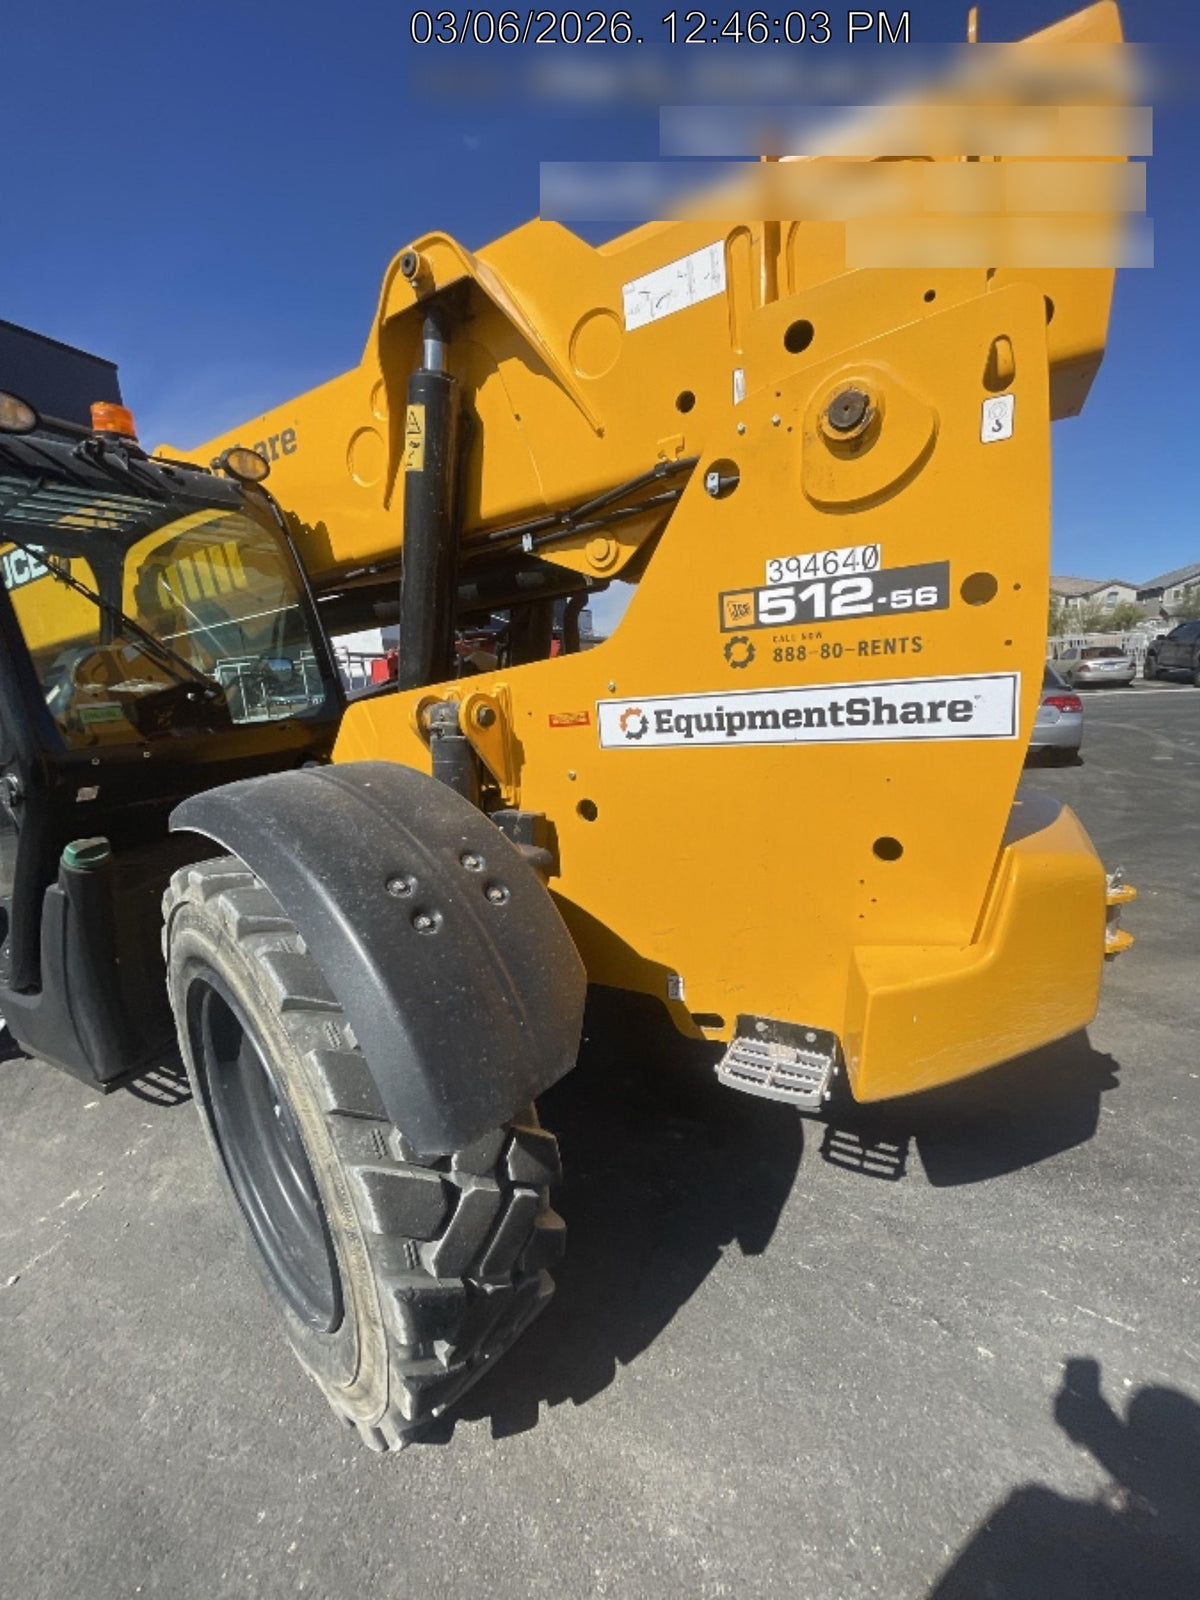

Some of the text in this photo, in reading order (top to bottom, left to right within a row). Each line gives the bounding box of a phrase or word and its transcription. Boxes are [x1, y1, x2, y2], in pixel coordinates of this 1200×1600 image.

[236, 427, 297, 462] are
[769, 545, 878, 583] 394640
[772, 631, 822, 643] CALL NOW
[773, 636, 923, 662] 888-80-RENTS
[654, 696, 974, 738] EquipmentShare
